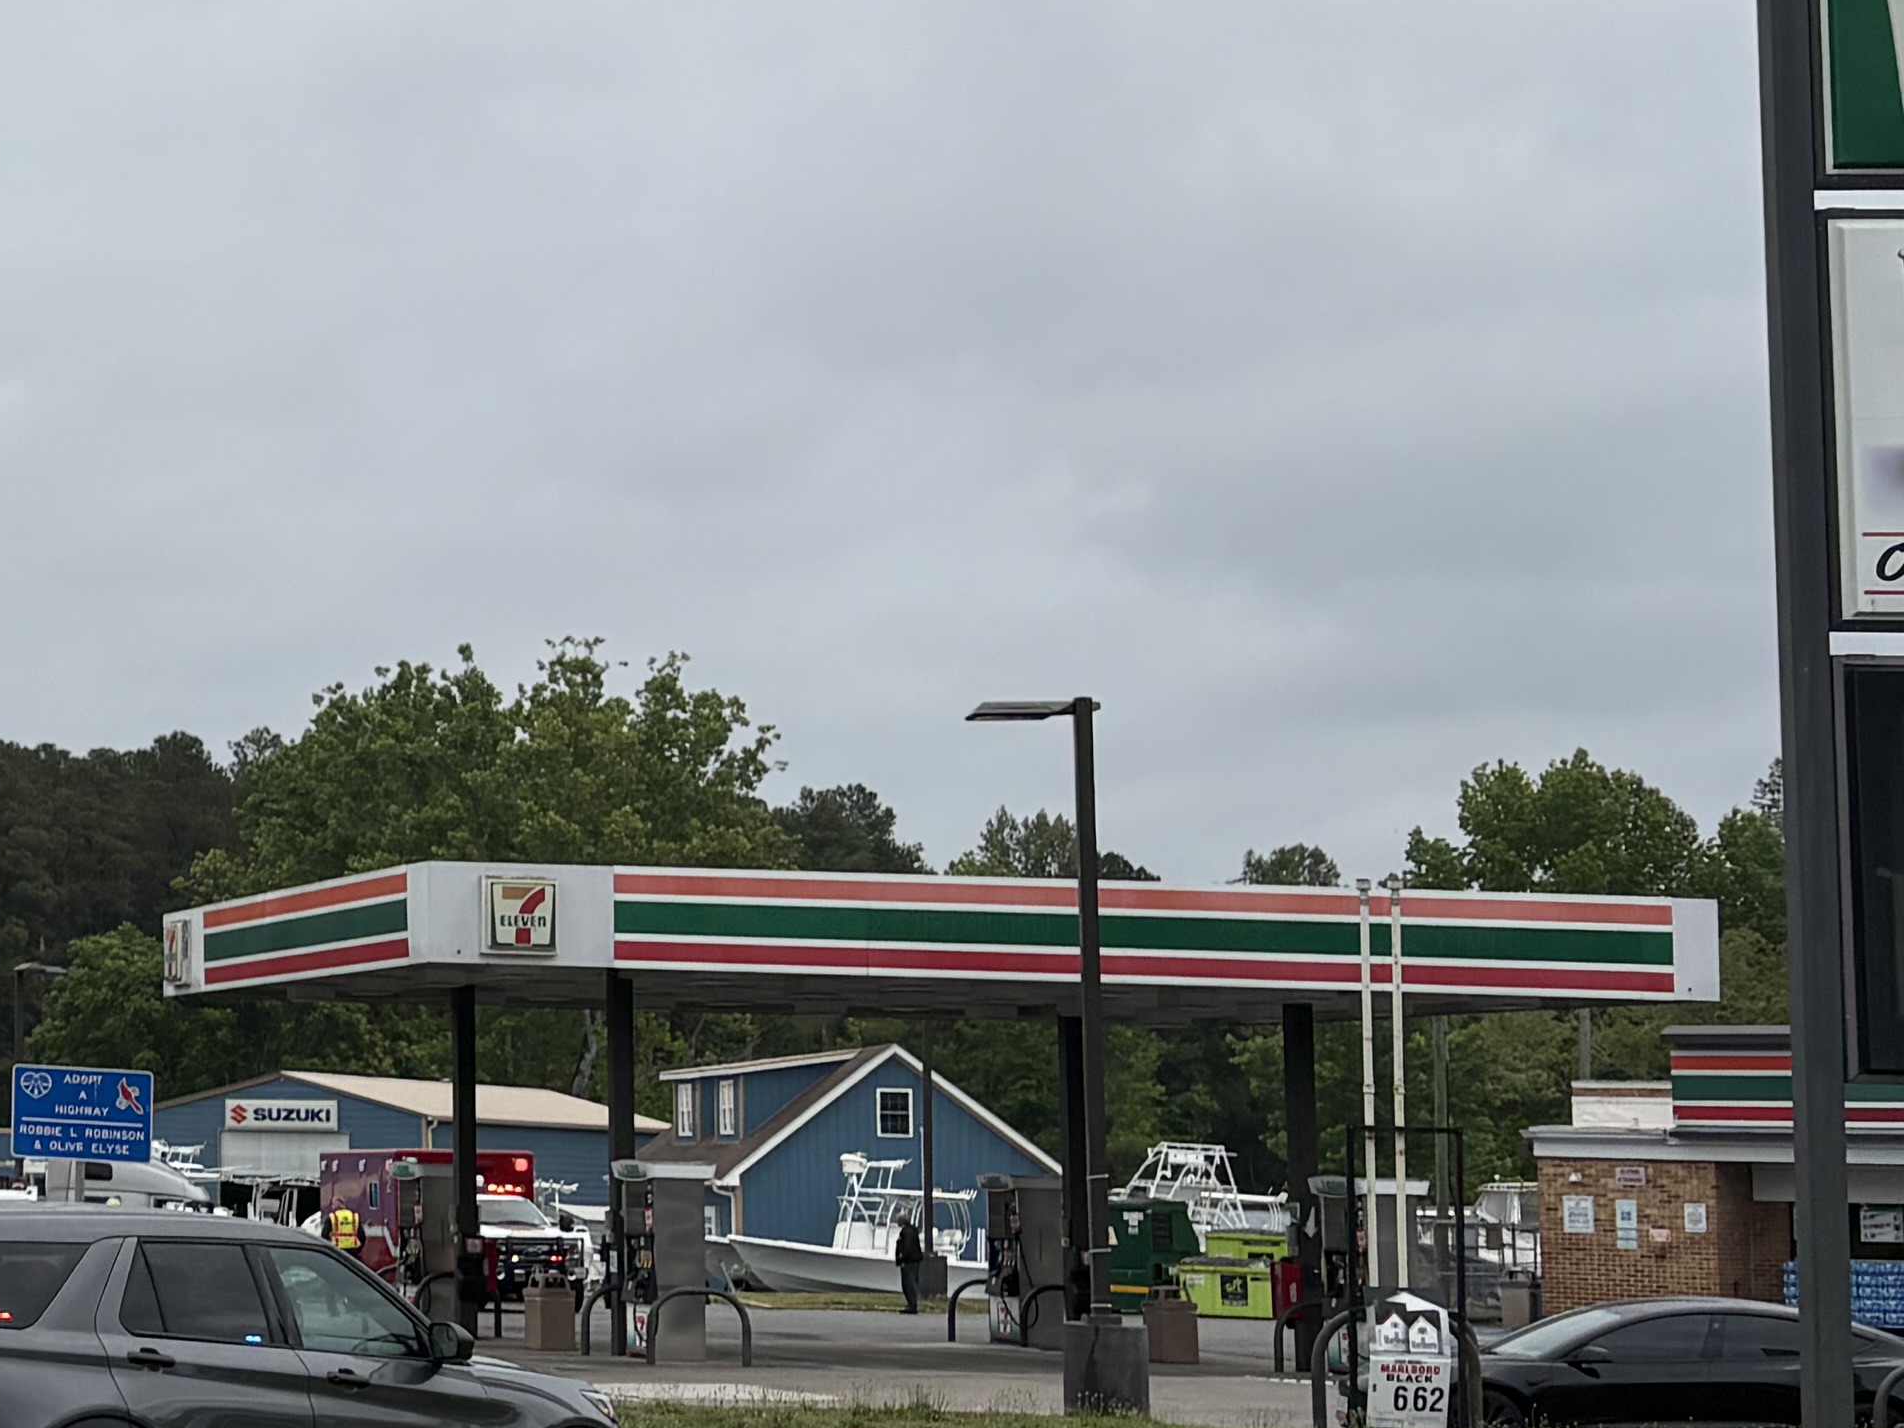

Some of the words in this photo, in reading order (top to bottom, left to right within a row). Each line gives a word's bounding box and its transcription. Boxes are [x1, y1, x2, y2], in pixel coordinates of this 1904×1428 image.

[502, 886, 545, 945] 7
[63, 1074, 102, 1085] ADOPT
[78, 1091, 87, 1100] A
[55, 1104, 109, 1116] HIGHWAY
[253, 1108, 331, 1123] SUZUKI
[19, 1124, 62, 1137] ROBBIE
[70, 1127, 77, 1137] L
[85, 1128, 145, 1141] ROBINSON
[91, 1143, 129, 1155] ELYSE
[1381, 1364, 1440, 1375] MARLBORO
[1386, 1374, 1433, 1383] BLACK
